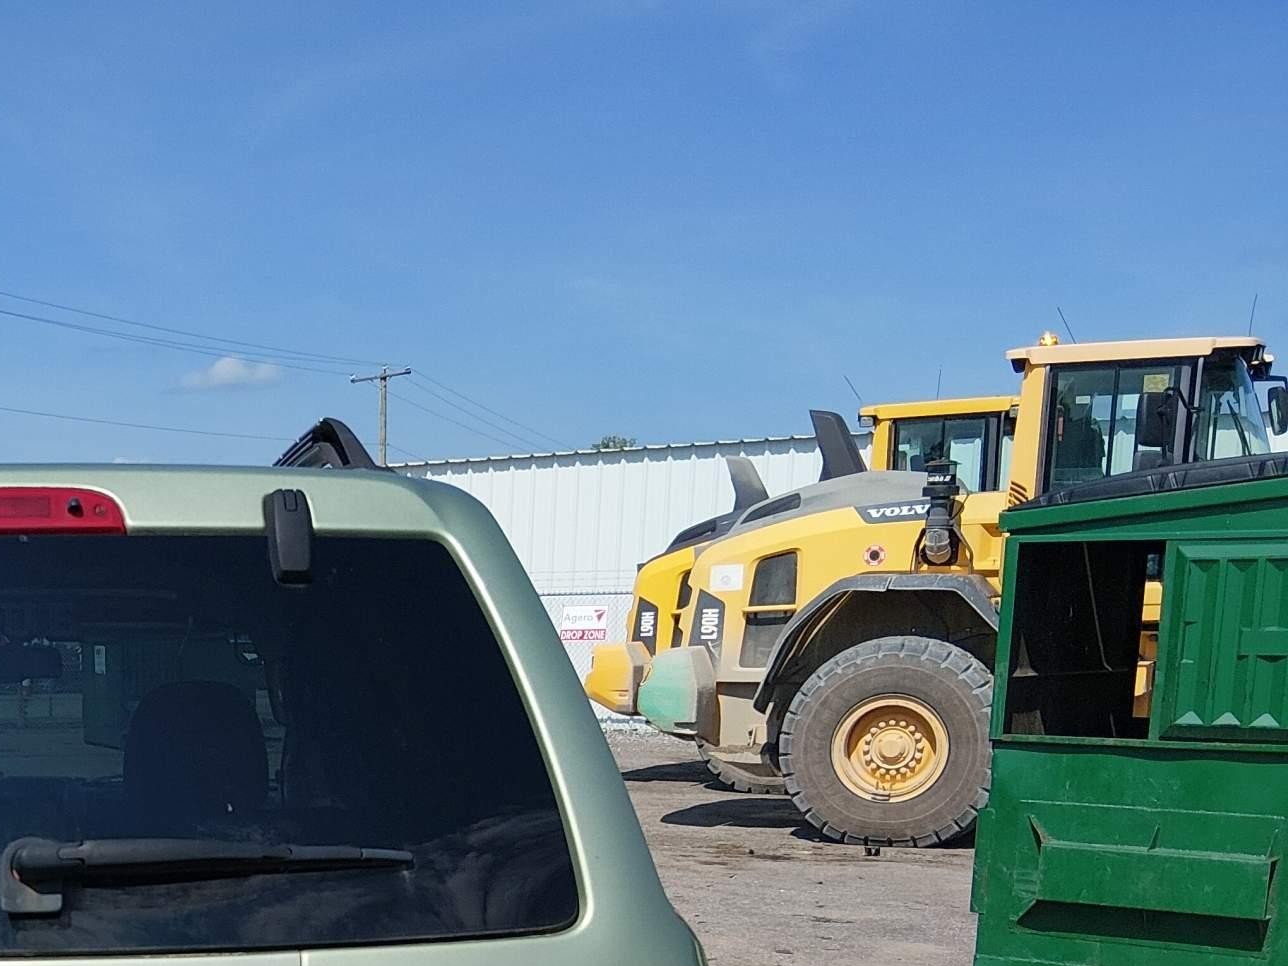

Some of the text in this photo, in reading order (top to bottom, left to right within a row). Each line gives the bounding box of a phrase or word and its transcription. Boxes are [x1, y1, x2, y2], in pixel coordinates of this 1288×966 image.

[867, 504, 930, 518] VOLV
[564, 614, 594, 625] Agero
[640, 611, 656, 637] L90H
[700, 608, 720, 640] L90H
[561, 629, 606, 640] DROP ZONE
